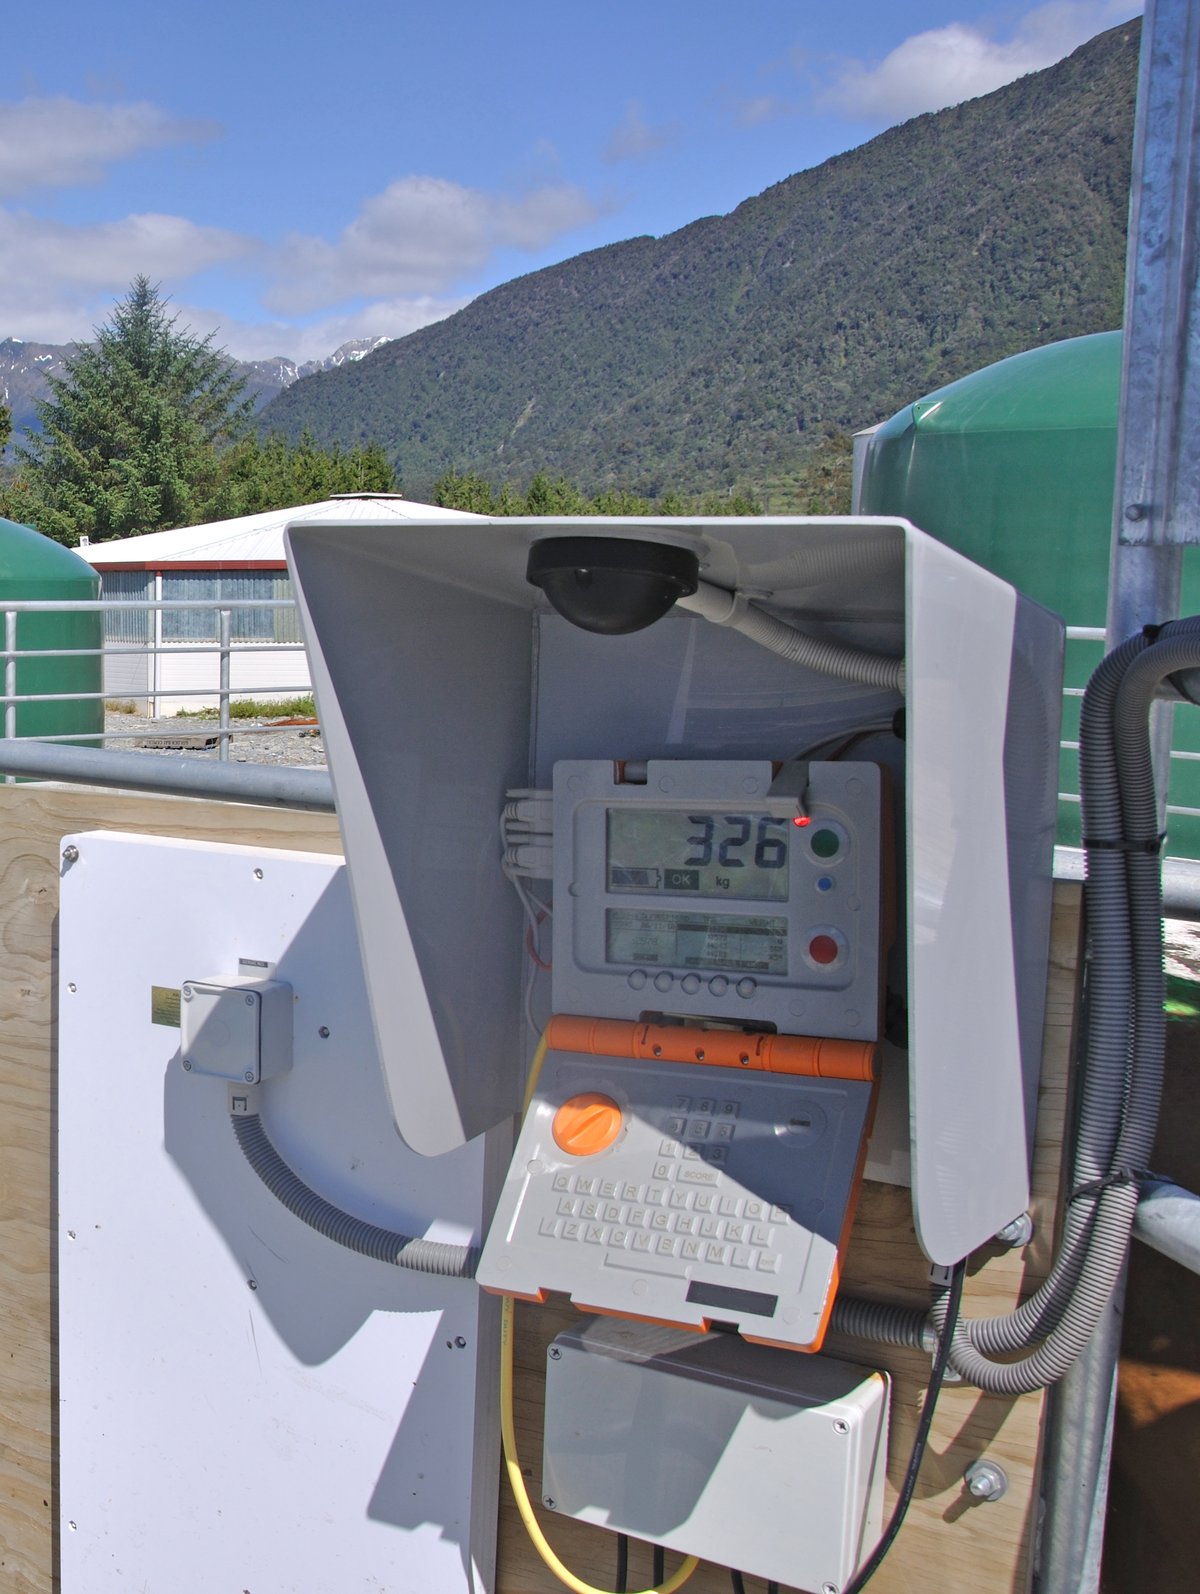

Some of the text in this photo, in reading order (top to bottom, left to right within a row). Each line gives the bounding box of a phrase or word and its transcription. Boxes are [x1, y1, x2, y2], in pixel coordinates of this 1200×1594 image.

[684, 815, 788, 868] 326
[671, 874, 730, 889] OK kg
[677, 1099, 733, 1114] 7 8 9
[665, 1143, 721, 1159] 1 2 3
[557, 1177, 567, 1187] Q
[579, 1180, 592, 1190] W
[603, 1183, 613, 1193] E
[626, 1186, 636, 1197] R
[651, 1189, 661, 1200] T
[676, 1192, 685, 1203] Y
[698, 1196, 709, 1207] U
[749, 1203, 760, 1214] O
[563, 1201, 764, 1240] A S D F G H J K L
[567, 1224, 577, 1234] Z
[591, 1227, 601, 1238] X
[614, 1231, 624, 1242] C
[639, 1235, 648, 1246] V
[662, 1239, 671, 1249] B
[686, 1243, 696, 1254] N
[710, 1246, 722, 1257] M
